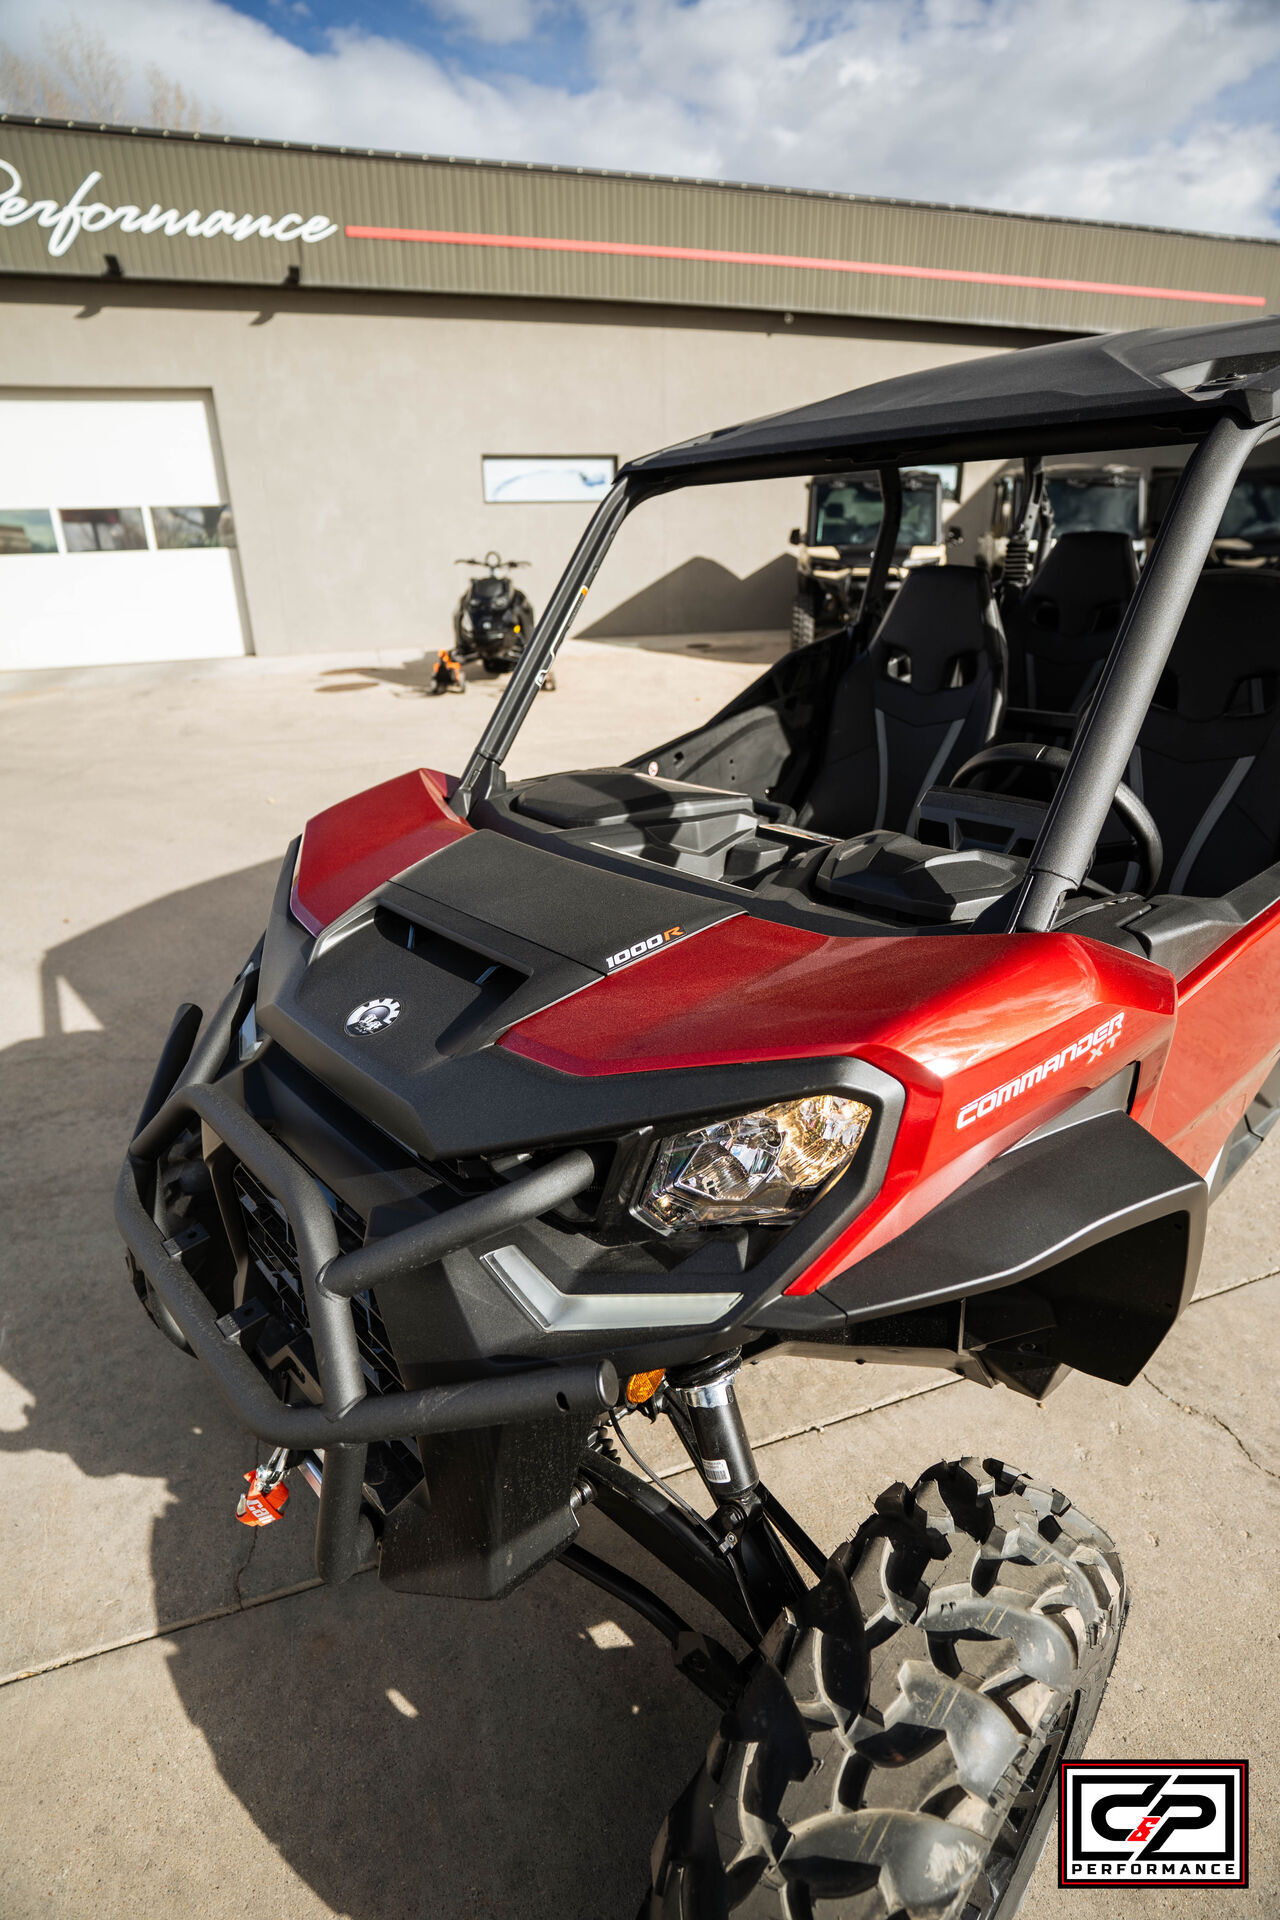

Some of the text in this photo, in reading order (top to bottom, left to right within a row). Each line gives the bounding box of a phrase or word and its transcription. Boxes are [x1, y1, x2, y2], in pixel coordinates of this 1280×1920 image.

[605, 926, 685, 969] 1000R
[1086, 1030, 1122, 1065] XT
[956, 1011, 1125, 1130] COMMANDER
